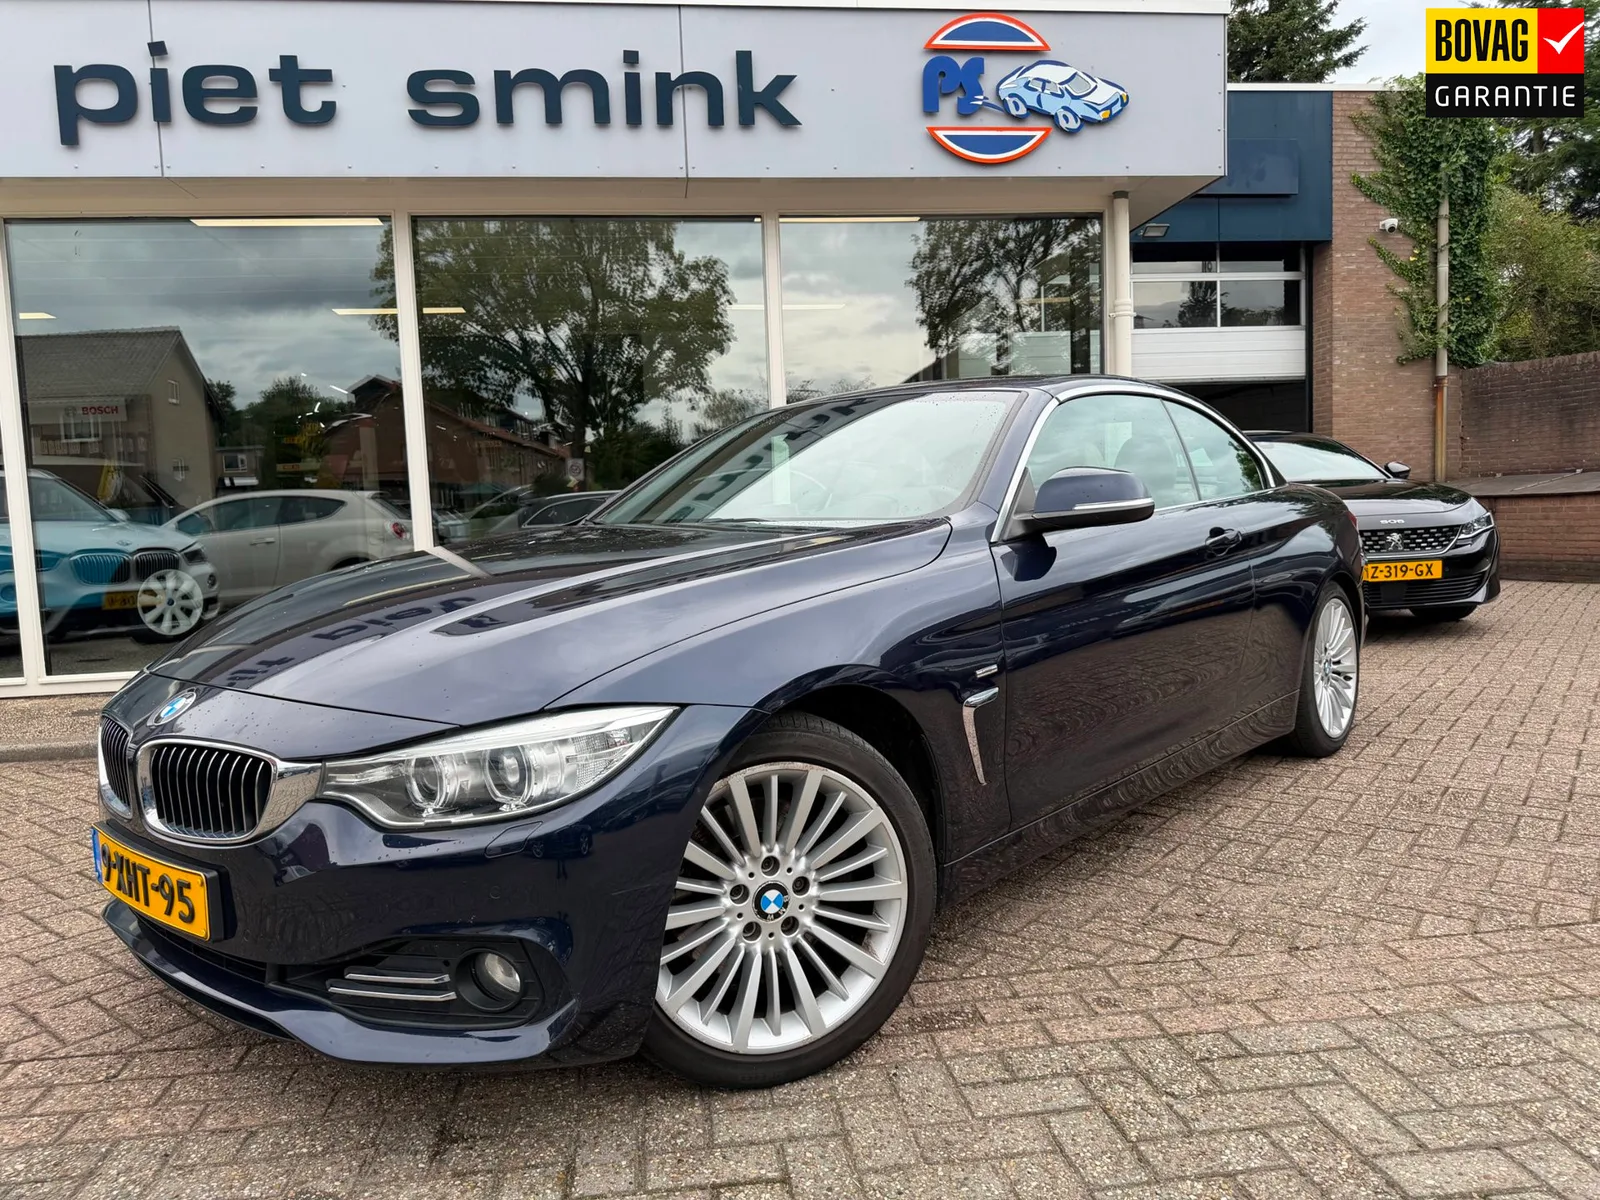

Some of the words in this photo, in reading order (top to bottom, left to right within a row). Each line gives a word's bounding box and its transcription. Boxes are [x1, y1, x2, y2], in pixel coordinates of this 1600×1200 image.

[53, 41, 338, 146] piet
[406, 50, 802, 127] smink
[81, 405, 118, 415] BOSCH
[101, 843, 195, 924] 9-XHT-95
